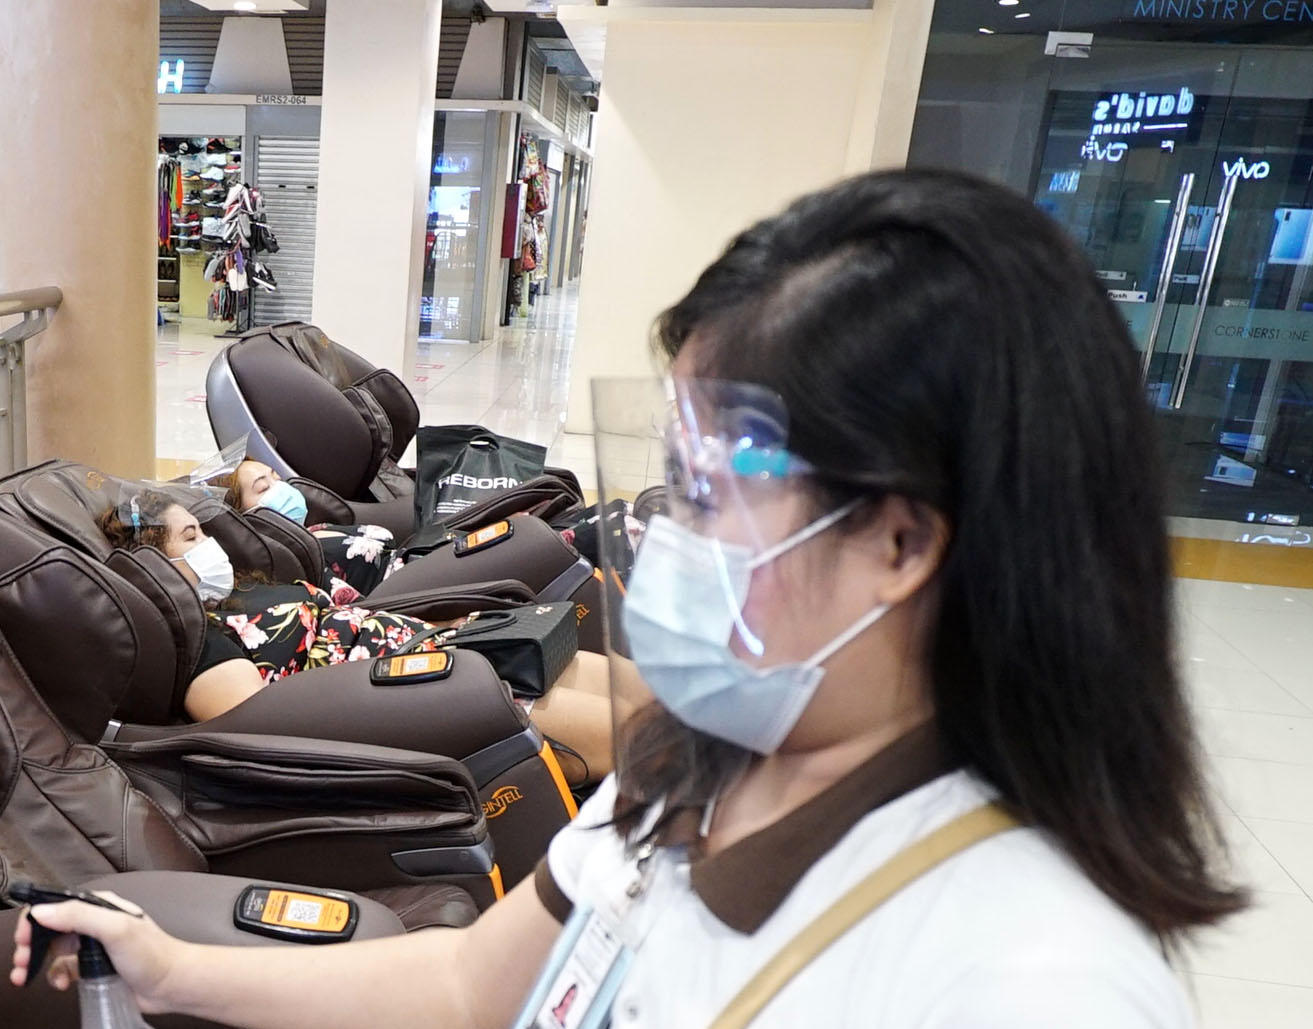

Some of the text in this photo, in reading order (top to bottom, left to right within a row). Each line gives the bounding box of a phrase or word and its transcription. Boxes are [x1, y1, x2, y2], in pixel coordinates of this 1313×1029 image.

[1134, 0, 1255, 20] MINISTRY
[256, 95, 307, 105] EMRS2-064
[1223, 157, 1270, 179] vivo
[1215, 324, 1310, 341] CORNERSTNE
